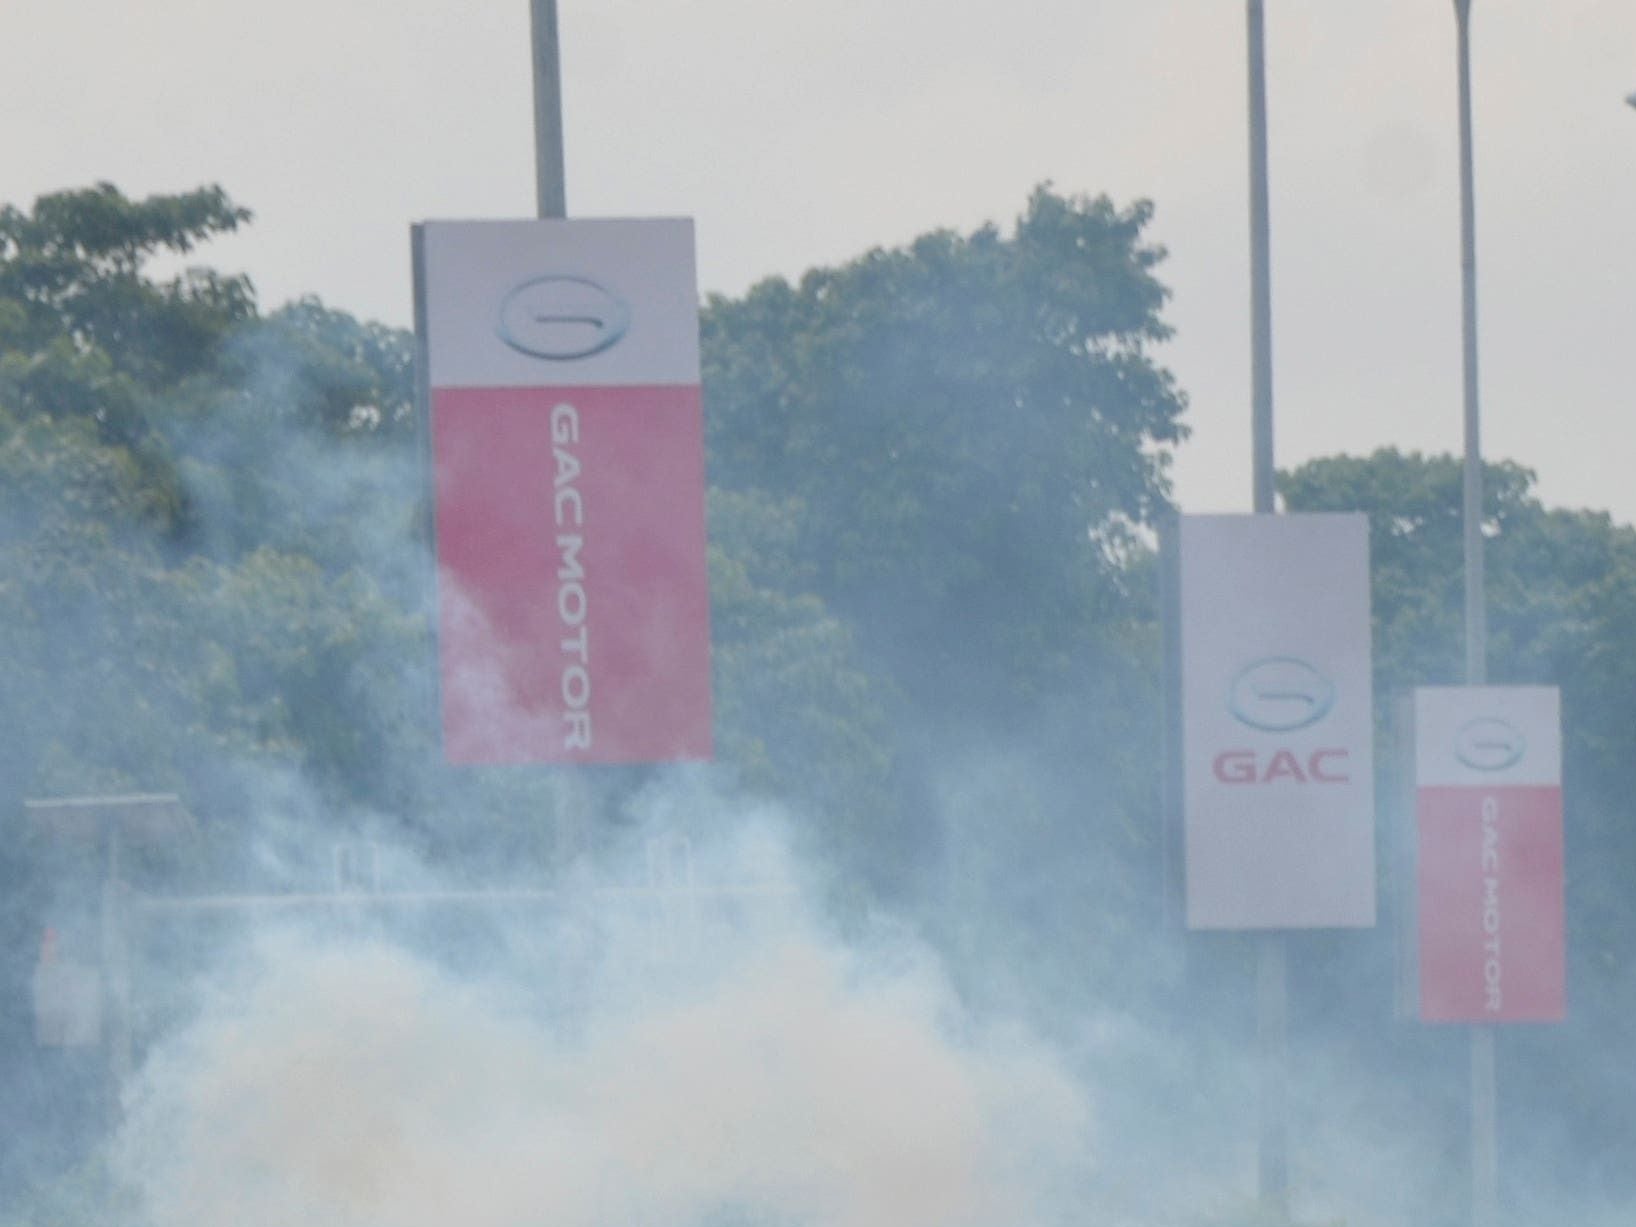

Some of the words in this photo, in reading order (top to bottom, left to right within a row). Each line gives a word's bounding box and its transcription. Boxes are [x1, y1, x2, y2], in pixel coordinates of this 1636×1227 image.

[551, 402, 582, 526] GAC
[557, 531, 592, 751] MOTOR
[1212, 748, 1349, 784] GAC
[1481, 796, 1498, 870] GAC
[1483, 877, 1502, 1013] MOTOR
